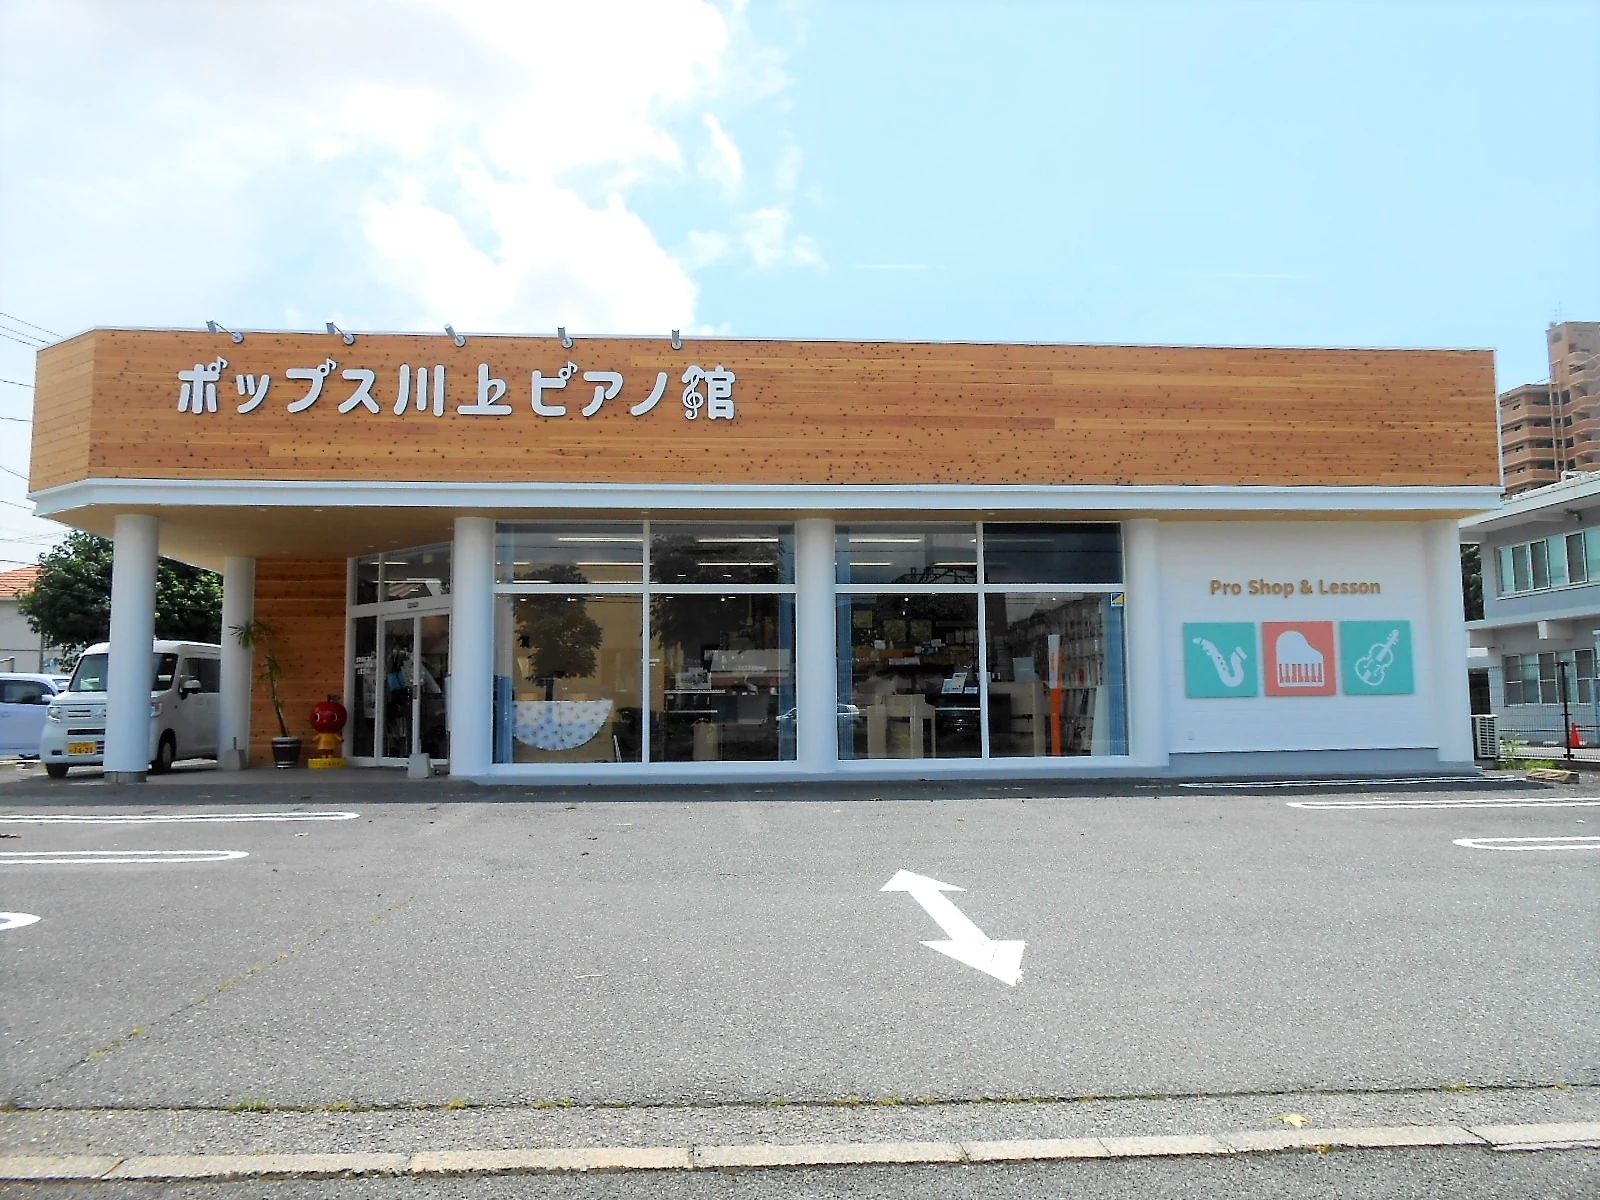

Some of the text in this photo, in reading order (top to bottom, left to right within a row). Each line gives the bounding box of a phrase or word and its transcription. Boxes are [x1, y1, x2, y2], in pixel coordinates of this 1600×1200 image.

[177, 356, 736, 420] ポップス川上ピアノ館
[1210, 579, 1381, 599] Pro Shop & Lesson
